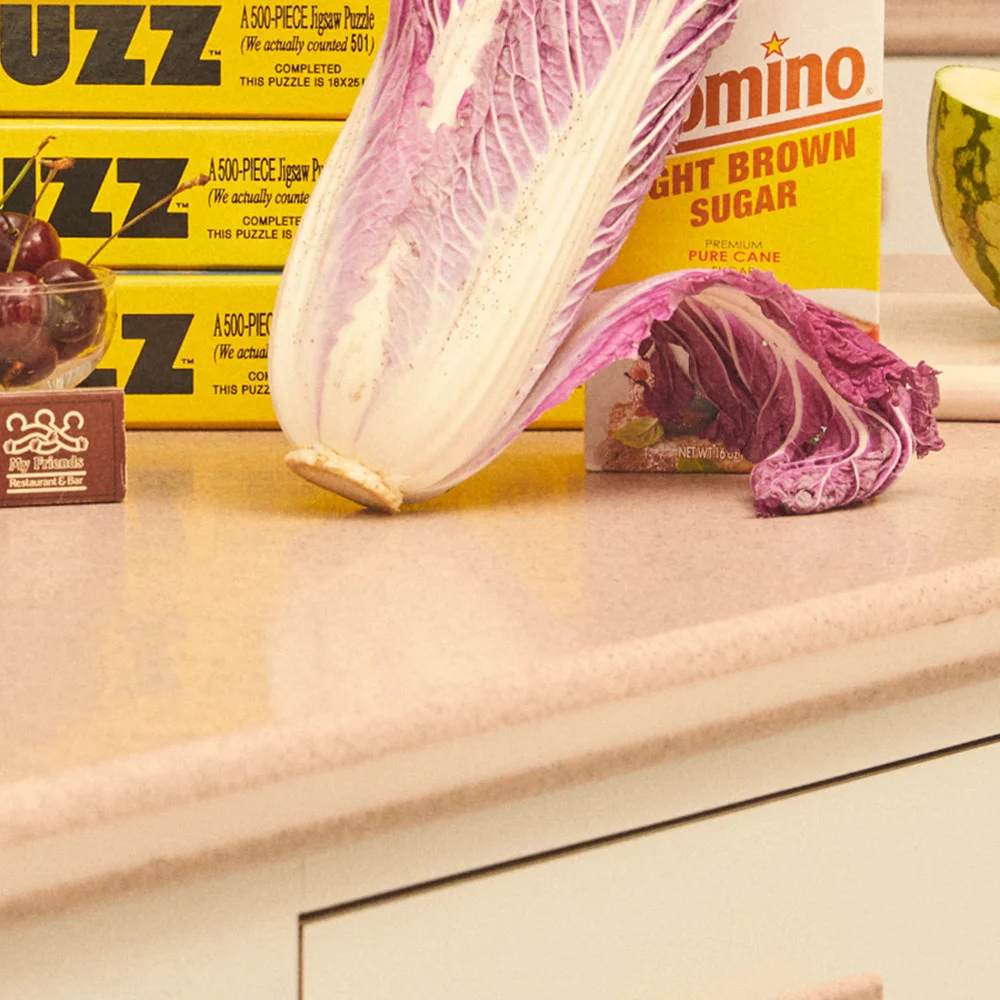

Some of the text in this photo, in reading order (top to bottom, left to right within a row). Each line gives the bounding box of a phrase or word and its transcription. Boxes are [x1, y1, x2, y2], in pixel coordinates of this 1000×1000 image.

[241, 6, 374, 35] A 500-PIECE Jigsaw Puzzle
[263, 36, 348, 54] actually counted
[275, 64, 341, 74] COMPLETED
[240, 77, 309, 87] THIS PUZZLE
[683, 46, 866, 135] omino
[648, 127, 857, 200] GHT BROWN
[218, 158, 310, 188] 500-PIECE Jigsaw
[232, 188, 272, 207] actually
[690, 179, 798, 228] SUGAR
[207, 229, 279, 240] THIS PUZZLE
[705, 239, 763, 250] PREMIUM
[688, 250, 781, 263] PURE CANE
[213, 385, 238, 395] THIS
[678, 446, 726, 460] NET WT 16
[8, 455, 84, 473] My Friends
[9, 476, 84, 488] Restaurant & Bar
